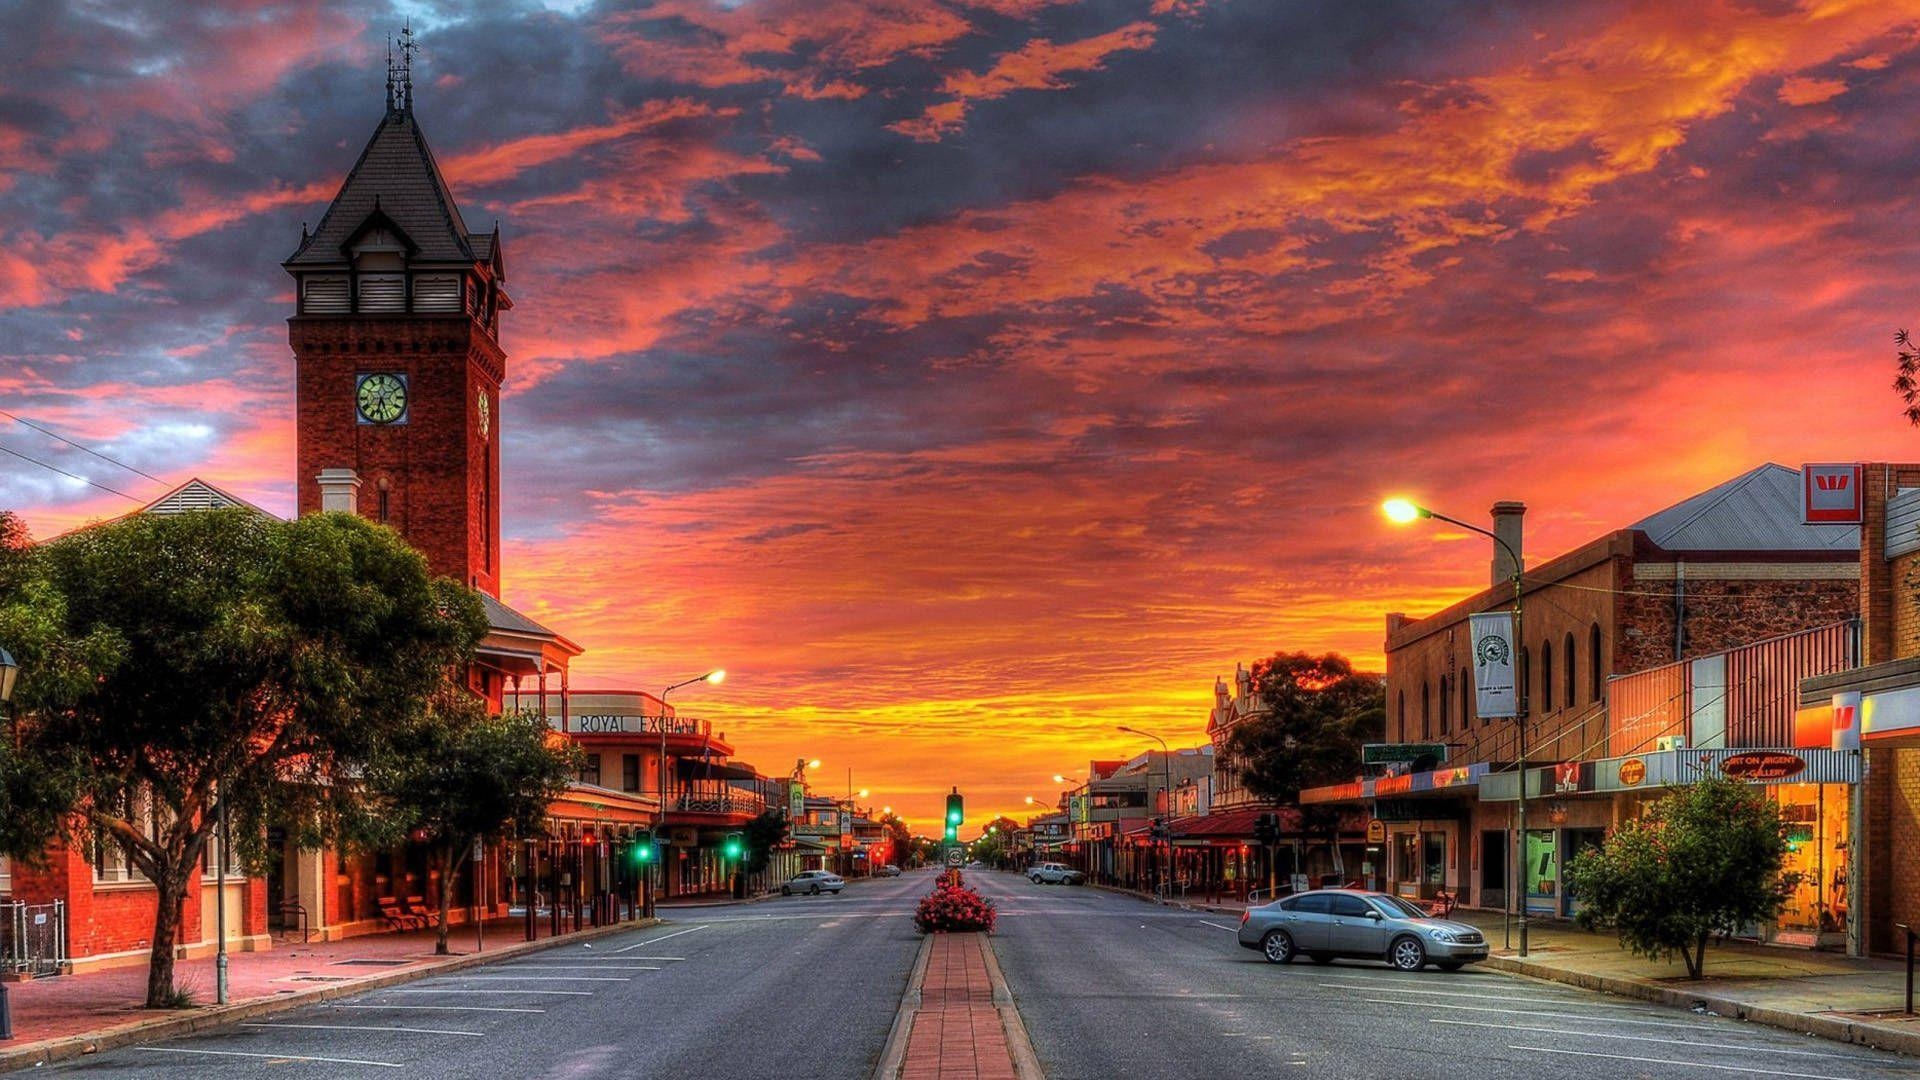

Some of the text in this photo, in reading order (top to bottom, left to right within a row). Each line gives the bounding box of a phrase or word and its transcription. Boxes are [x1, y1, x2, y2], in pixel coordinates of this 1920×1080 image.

[581, 716, 625, 732] ROYAL
[1726, 757, 1744, 769] ART
[1760, 756, 1795, 767] ARGENT
[1747, 769, 1786, 777] GALLERY
